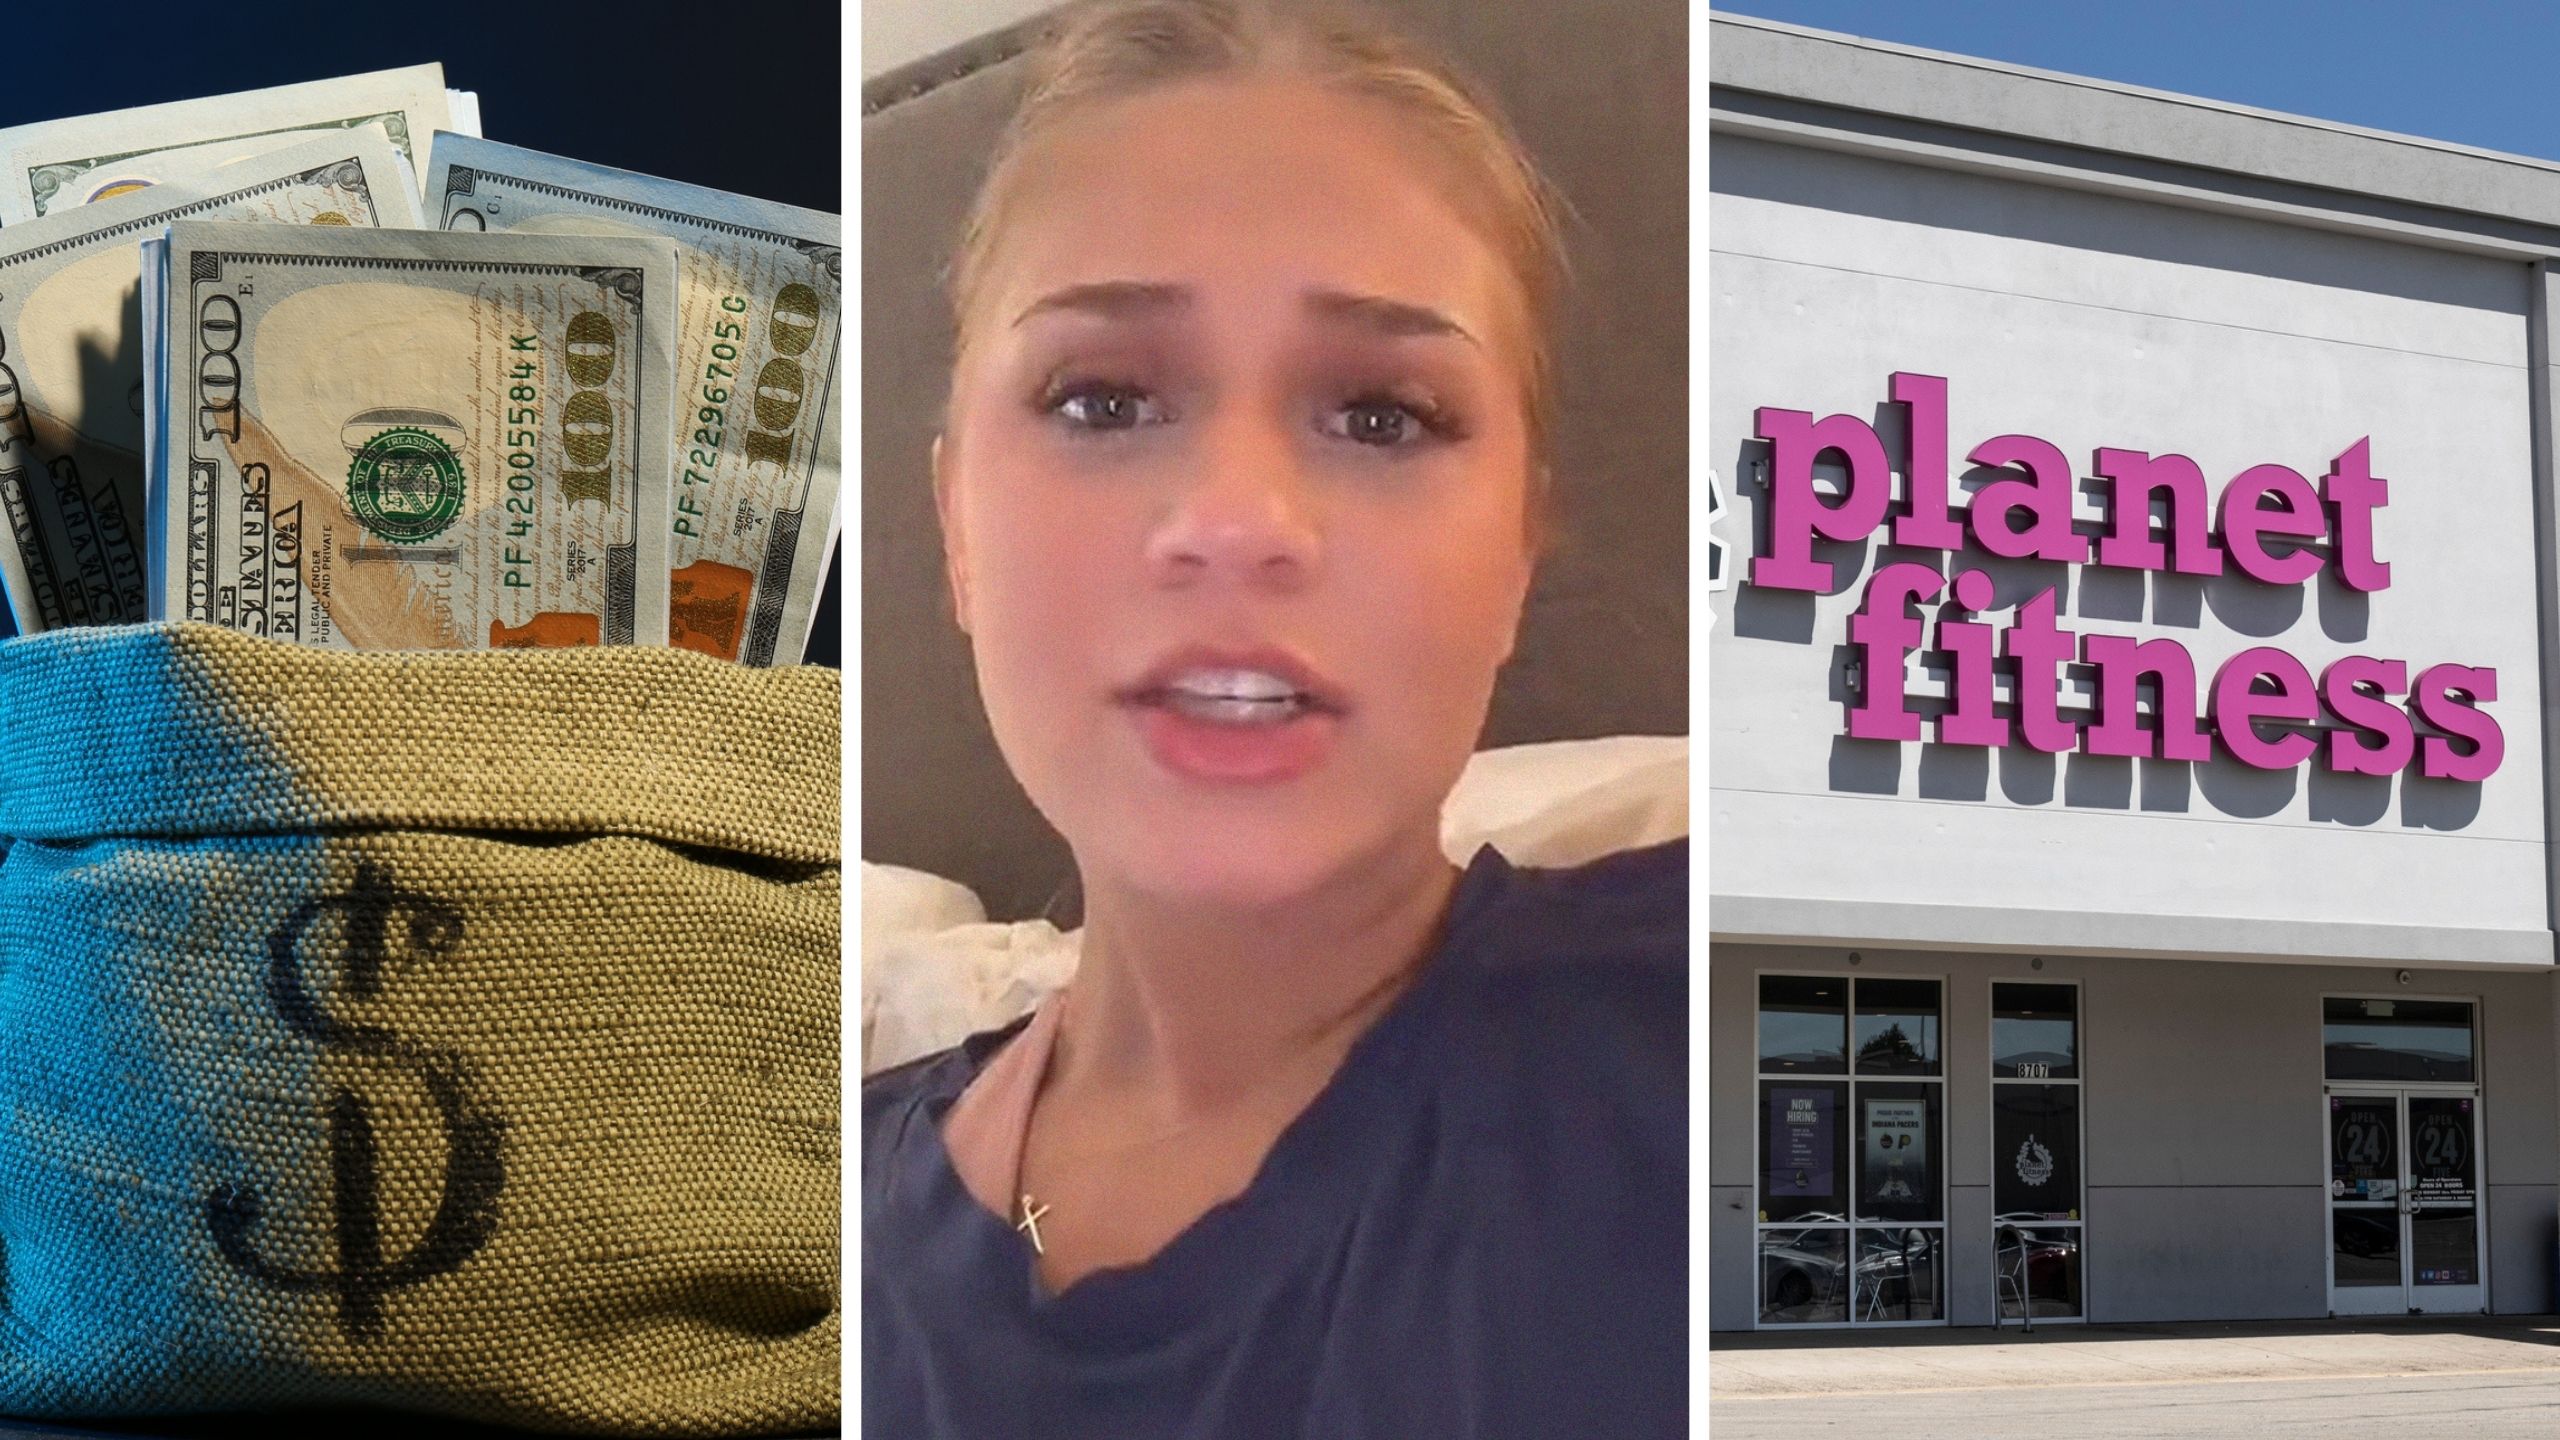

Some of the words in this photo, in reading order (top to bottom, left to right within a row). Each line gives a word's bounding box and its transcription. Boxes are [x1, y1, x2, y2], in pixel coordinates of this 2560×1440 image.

[510, 333, 537, 351] K
[197, 293, 242, 442] 100
[739, 279, 825, 478] 100
[560, 310, 616, 513] 100
[682, 320, 744, 489] 72296705
[356, 469, 366, 484] OF
[384, 436, 440, 456] TREASURY
[504, 363, 538, 537] 42005584
[1749, 371, 2391, 594] planet
[732, 496, 748, 536] SERIES
[743, 506, 756, 531] 2017
[754, 516, 763, 525] A
[93, 478, 145, 622] ERICA
[191, 467, 209, 620] DOLLARS
[238, 462, 269, 636] STATES
[322, 525, 331, 569] PRIVATE
[566, 540, 576, 581] SERIES
[576, 549, 586, 572] 2017
[587, 557, 595, 565] A
[271, 500, 302, 640] ERICA
[311, 549, 321, 595] TENDER
[321, 573, 331, 597] AND
[311, 598, 320, 633] LEGAL
[321, 599, 330, 642] PUBLIC
[1845, 562, 2506, 782] fitness
[2018, 1063, 2049, 1078] 8707
[1786, 1111, 1818, 1123] HIRING
[1791, 1099, 1813, 1110] NOW
[2350, 1112, 2377, 1123] OPEN
[2427, 1114, 2453, 1126] OPEN
[2346, 1124, 2381, 1164] 24
[2424, 1127, 2459, 1165] 24
